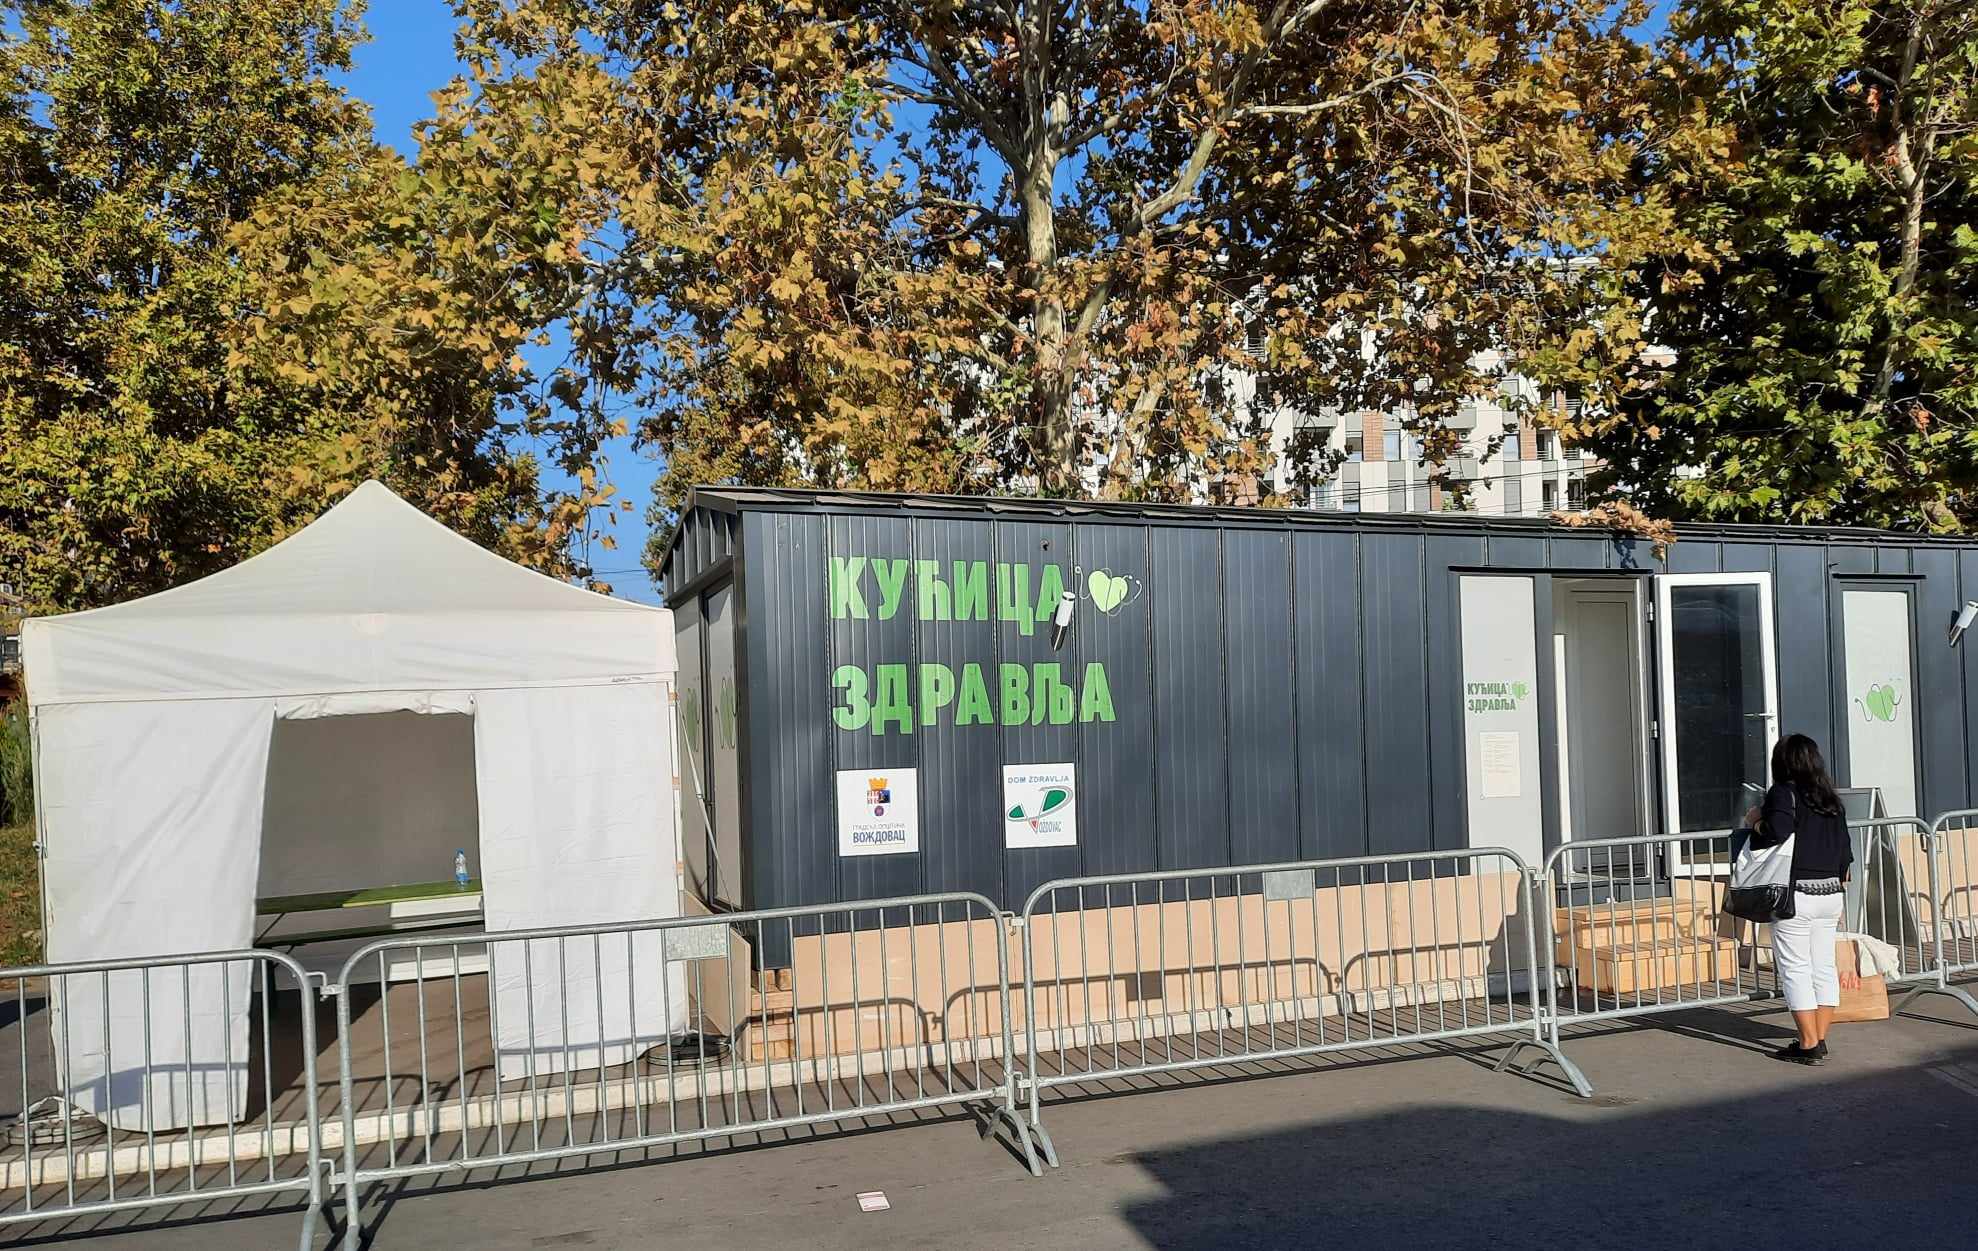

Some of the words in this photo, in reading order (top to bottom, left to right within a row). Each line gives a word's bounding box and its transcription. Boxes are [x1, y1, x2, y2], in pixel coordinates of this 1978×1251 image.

[829, 556, 1068, 636] КУЋИЦА
[1467, 682, 1507, 697] КУЋИЦА
[831, 662, 1117, 736] ЗДРАВЉА
[1468, 698, 1516, 713] ЗДРАВЉА
[1007, 776, 1026, 784] DOM
[1028, 775, 1070, 784] ZDRAVLJA
[853, 830, 906, 844] ВОЖДОВАЦ
